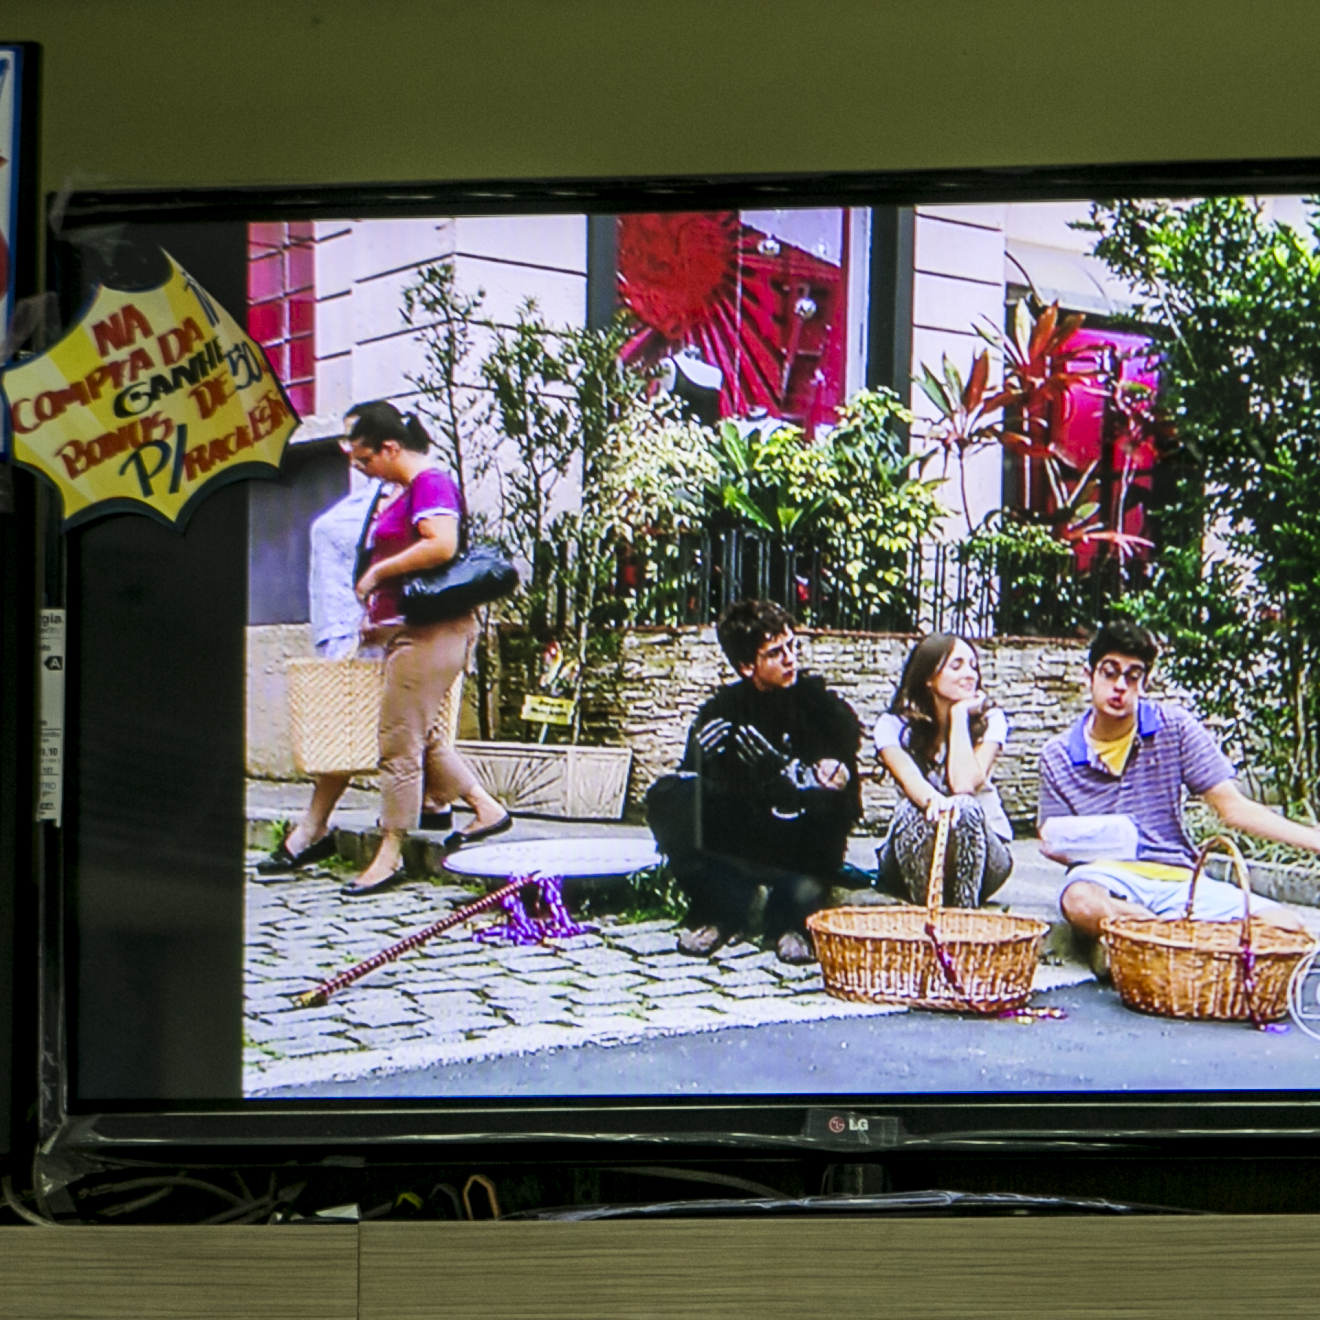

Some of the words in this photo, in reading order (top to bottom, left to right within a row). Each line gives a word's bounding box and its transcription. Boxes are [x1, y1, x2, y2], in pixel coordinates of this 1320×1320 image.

[92, 304, 153, 357] NA
[157, 317, 205, 367] DA
[848, 1118, 869, 1131] LG
